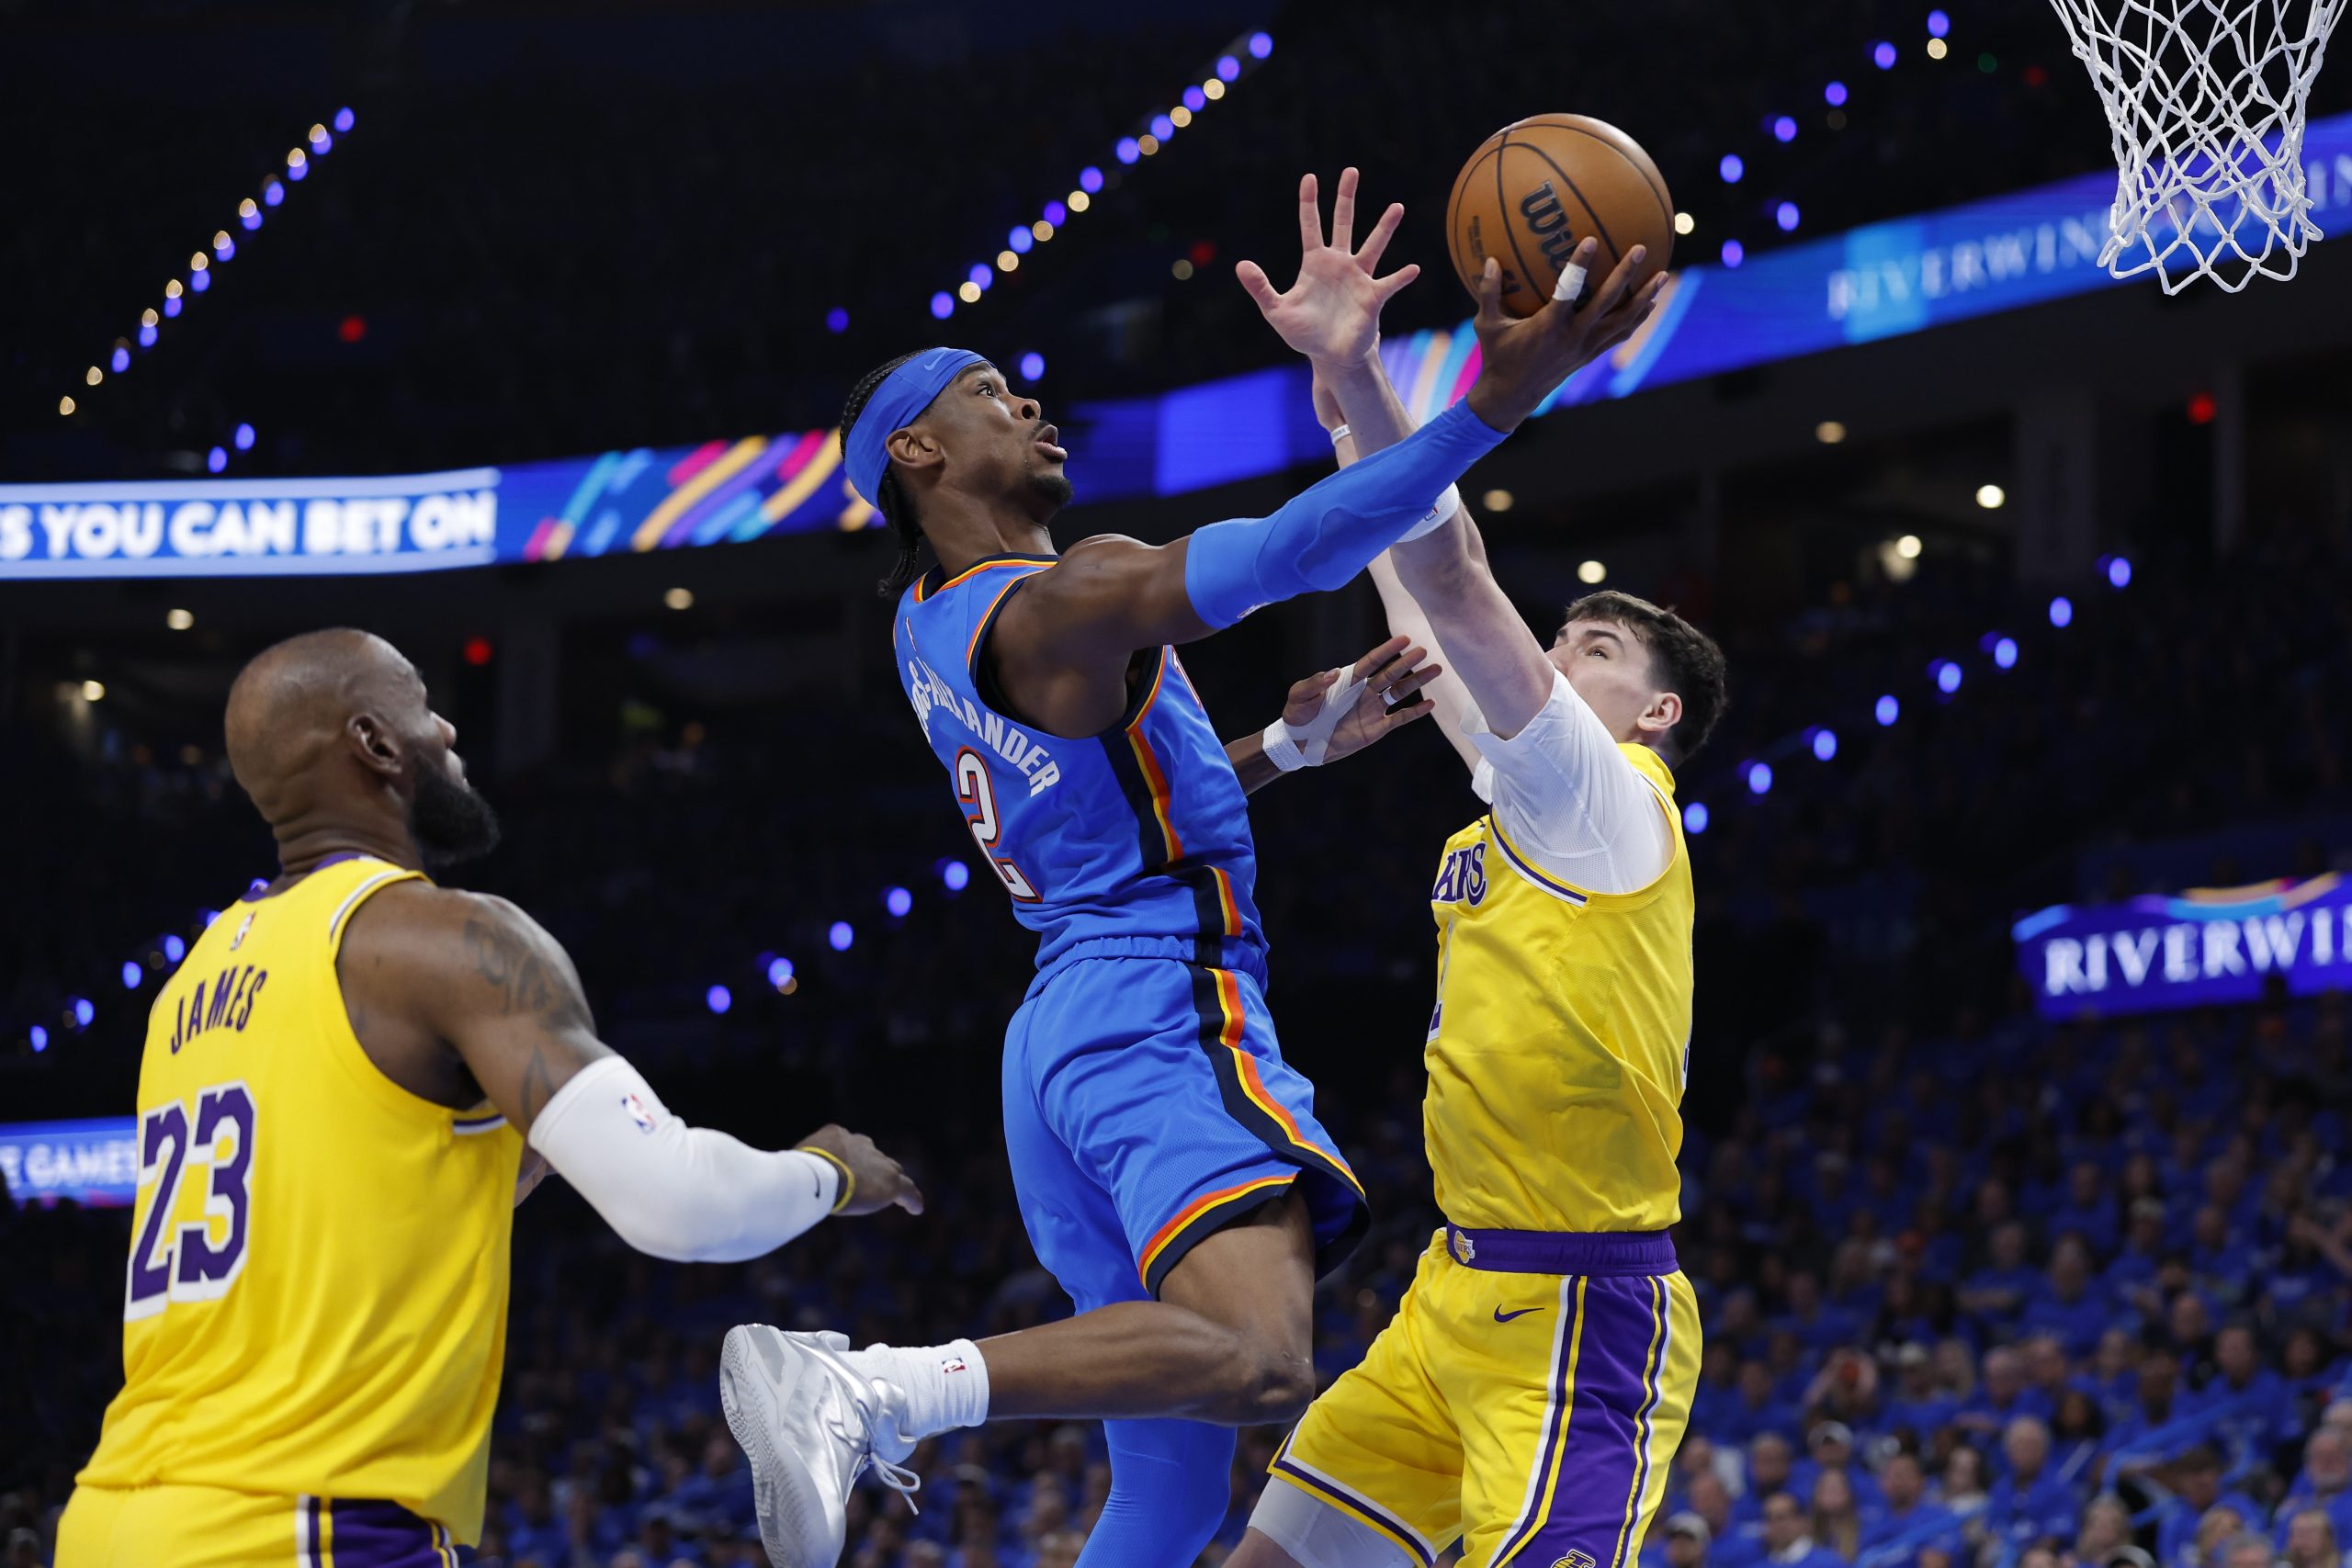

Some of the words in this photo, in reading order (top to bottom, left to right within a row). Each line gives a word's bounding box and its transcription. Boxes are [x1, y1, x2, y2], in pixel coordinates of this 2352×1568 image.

[40, 502, 164, 559] YOU
[169, 501, 297, 557] CAN
[303, 497, 412, 554] BET
[408, 490, 497, 550] ON
[956, 746, 1044, 903] 2
[2044, 904, 2352, 997] RIVERWI
[171, 964, 268, 1056] JAMES
[123, 1078, 257, 1323] 23
